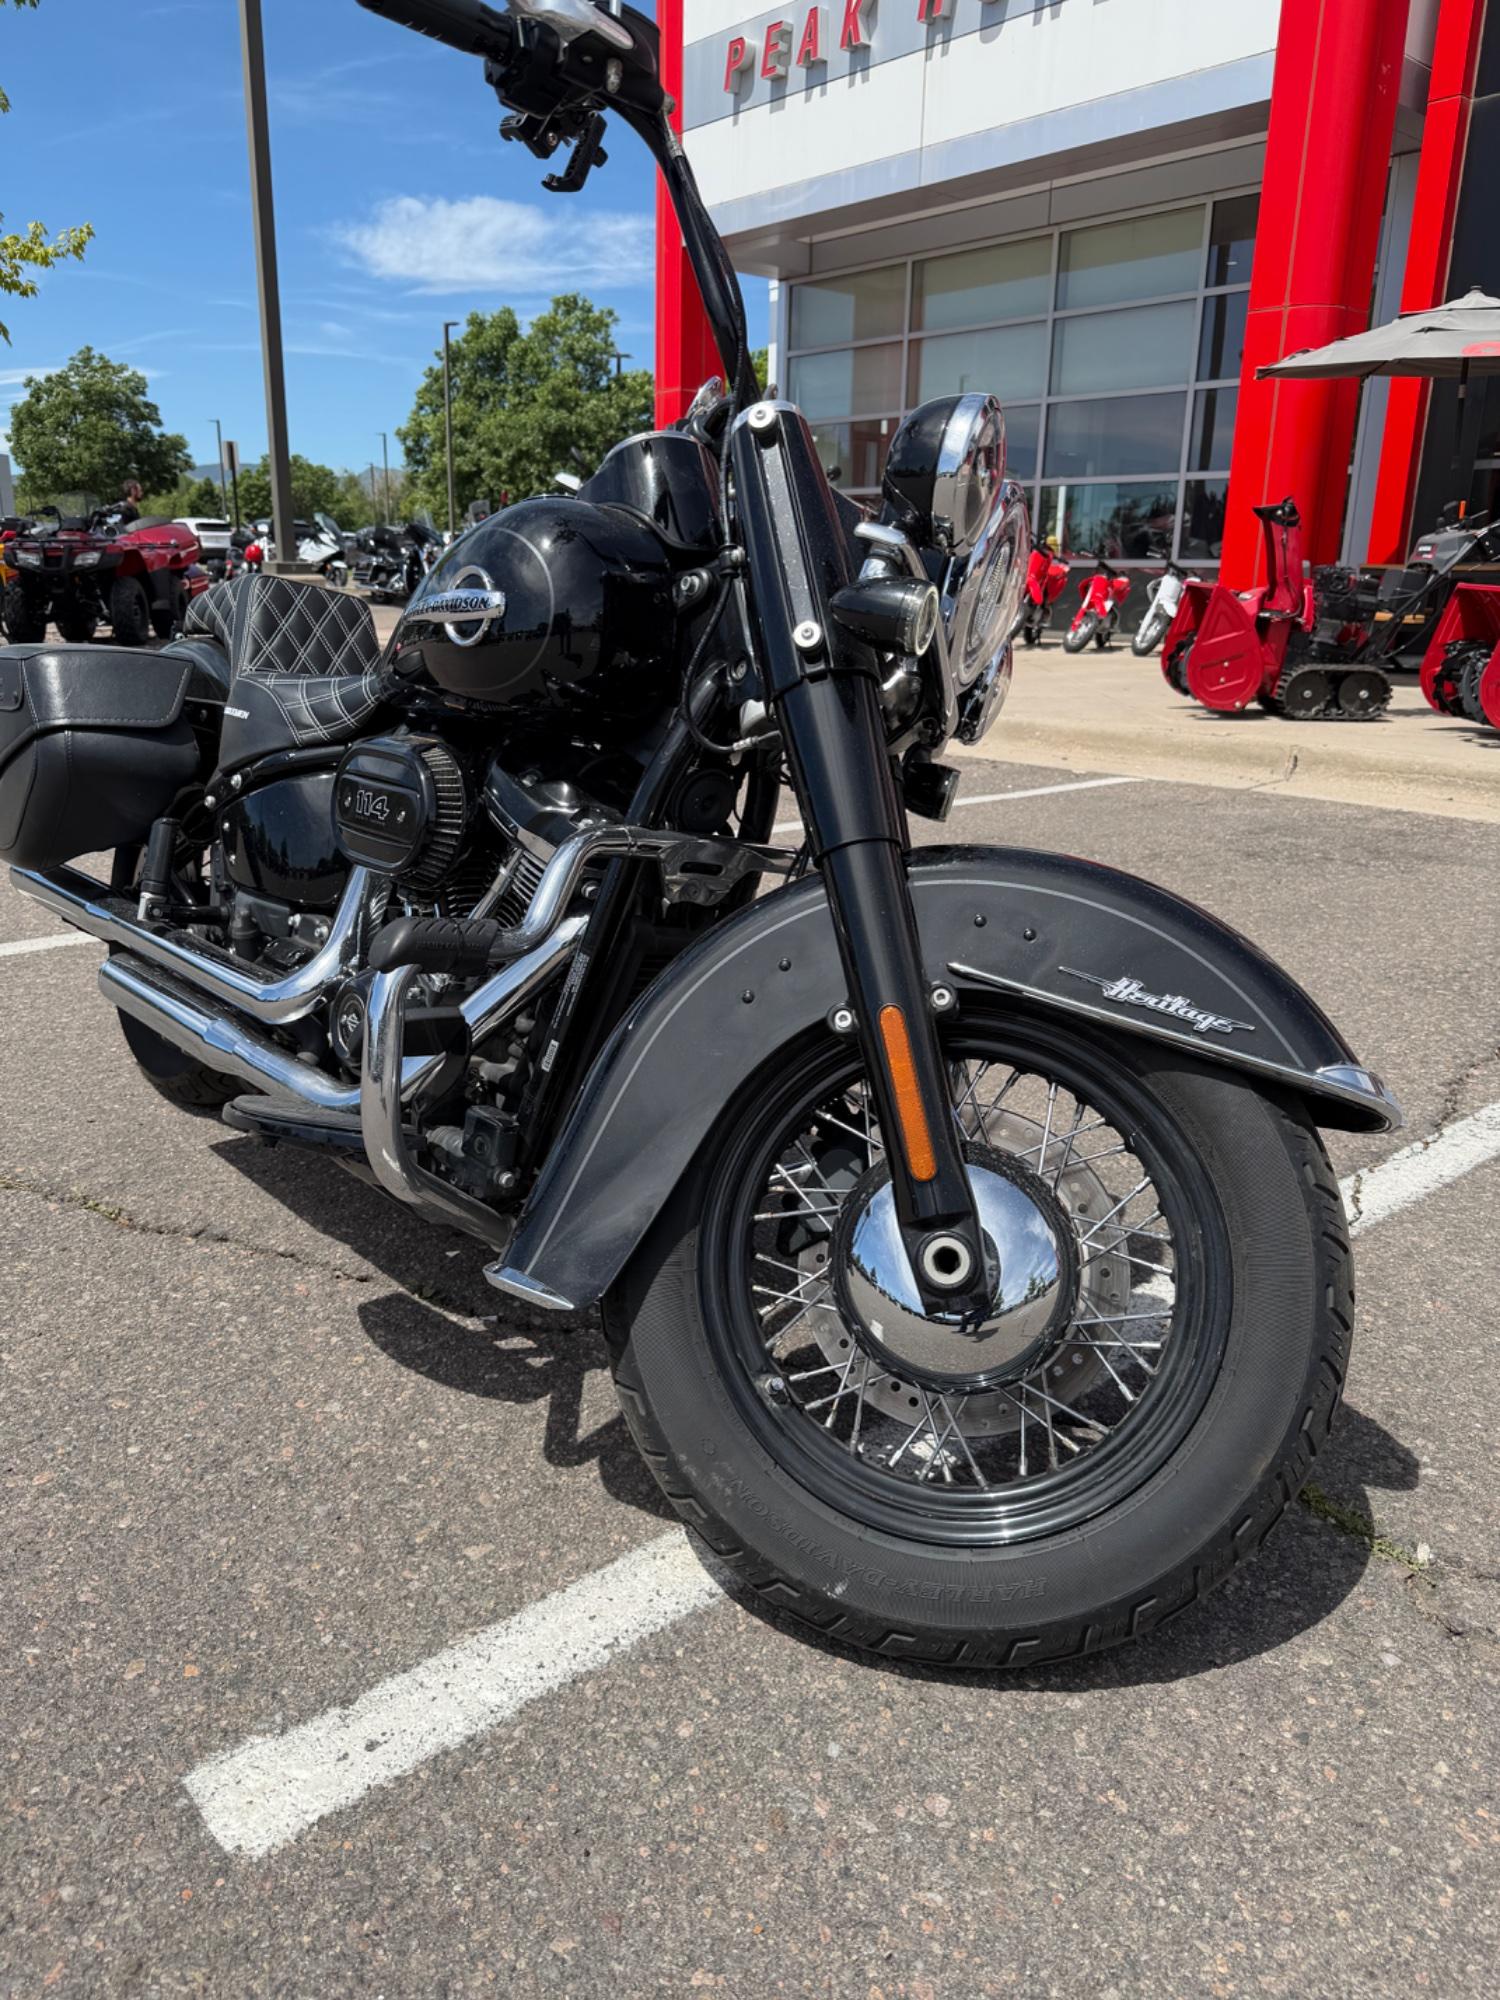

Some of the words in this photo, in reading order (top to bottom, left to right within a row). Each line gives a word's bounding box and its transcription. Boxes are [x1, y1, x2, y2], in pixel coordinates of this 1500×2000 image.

[724, 0, 868, 94] PEAK
[355, 789, 390, 820] 114
[1100, 976, 1236, 1034] Heritage
